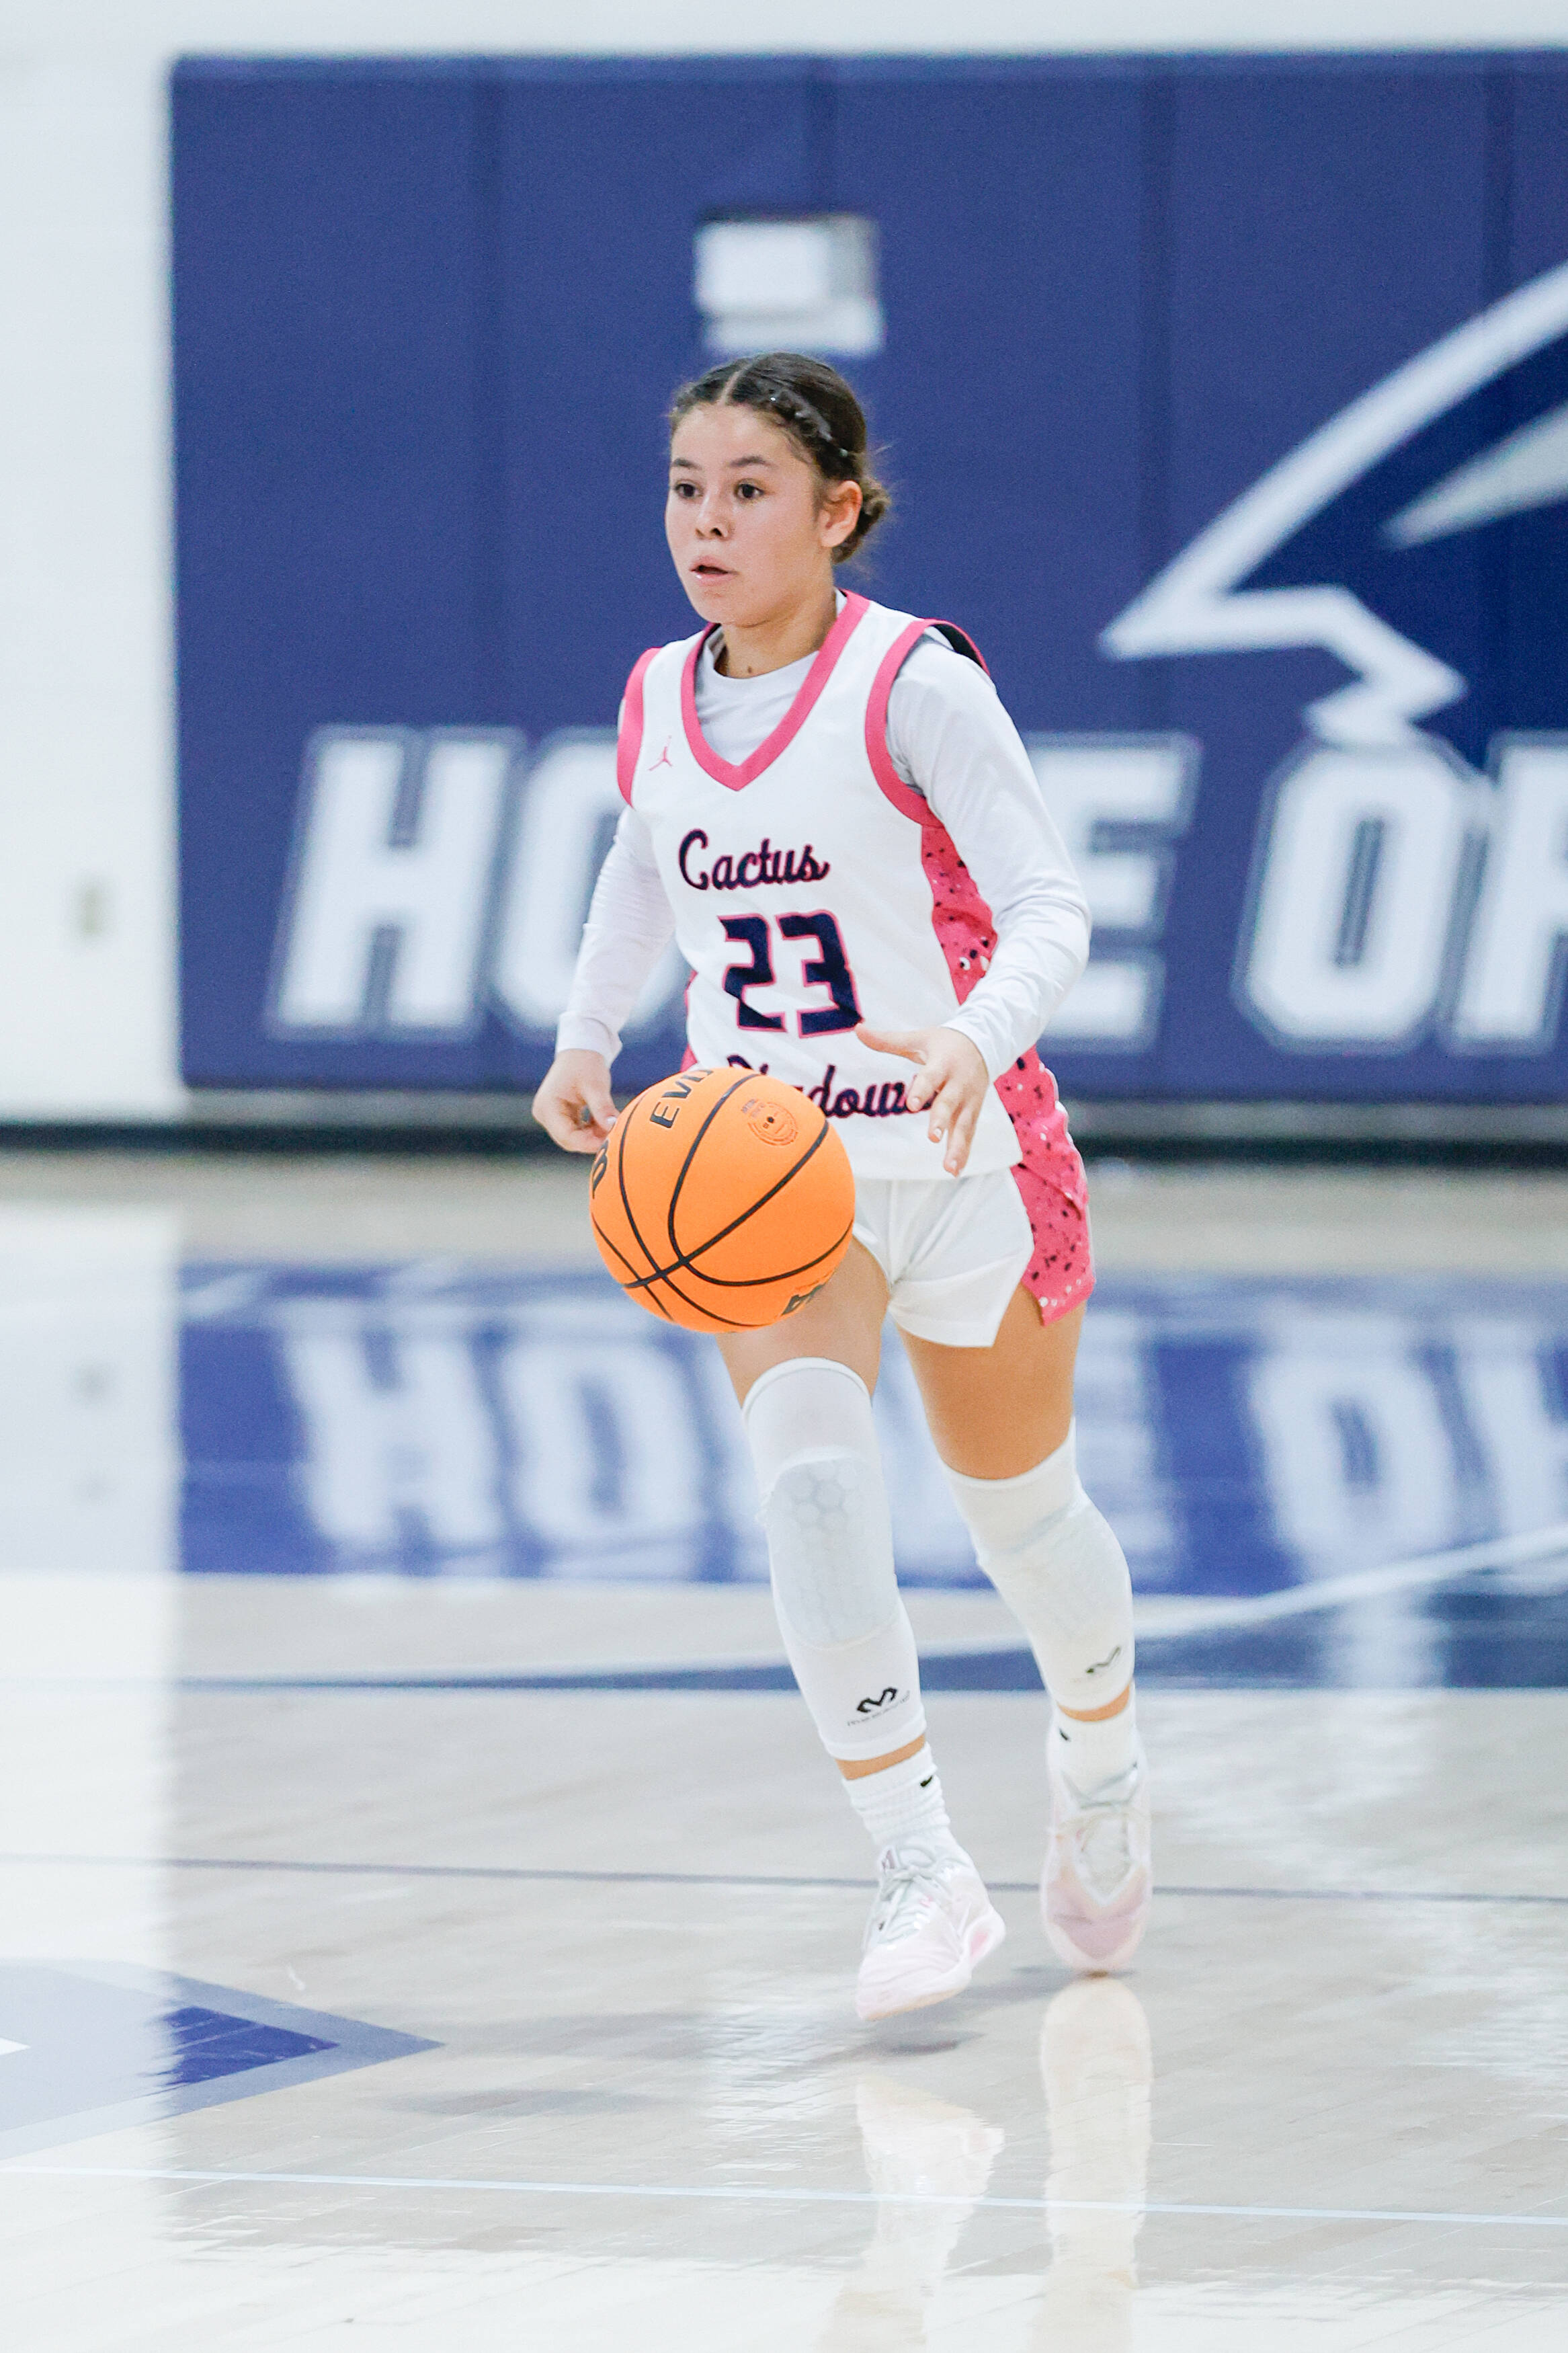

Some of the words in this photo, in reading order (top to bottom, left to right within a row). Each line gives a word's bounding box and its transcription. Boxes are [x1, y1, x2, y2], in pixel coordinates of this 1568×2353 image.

[264, 725, 1200, 1051] HOE
[679, 828, 831, 891] Cactus
[717, 910, 864, 1039] 23
